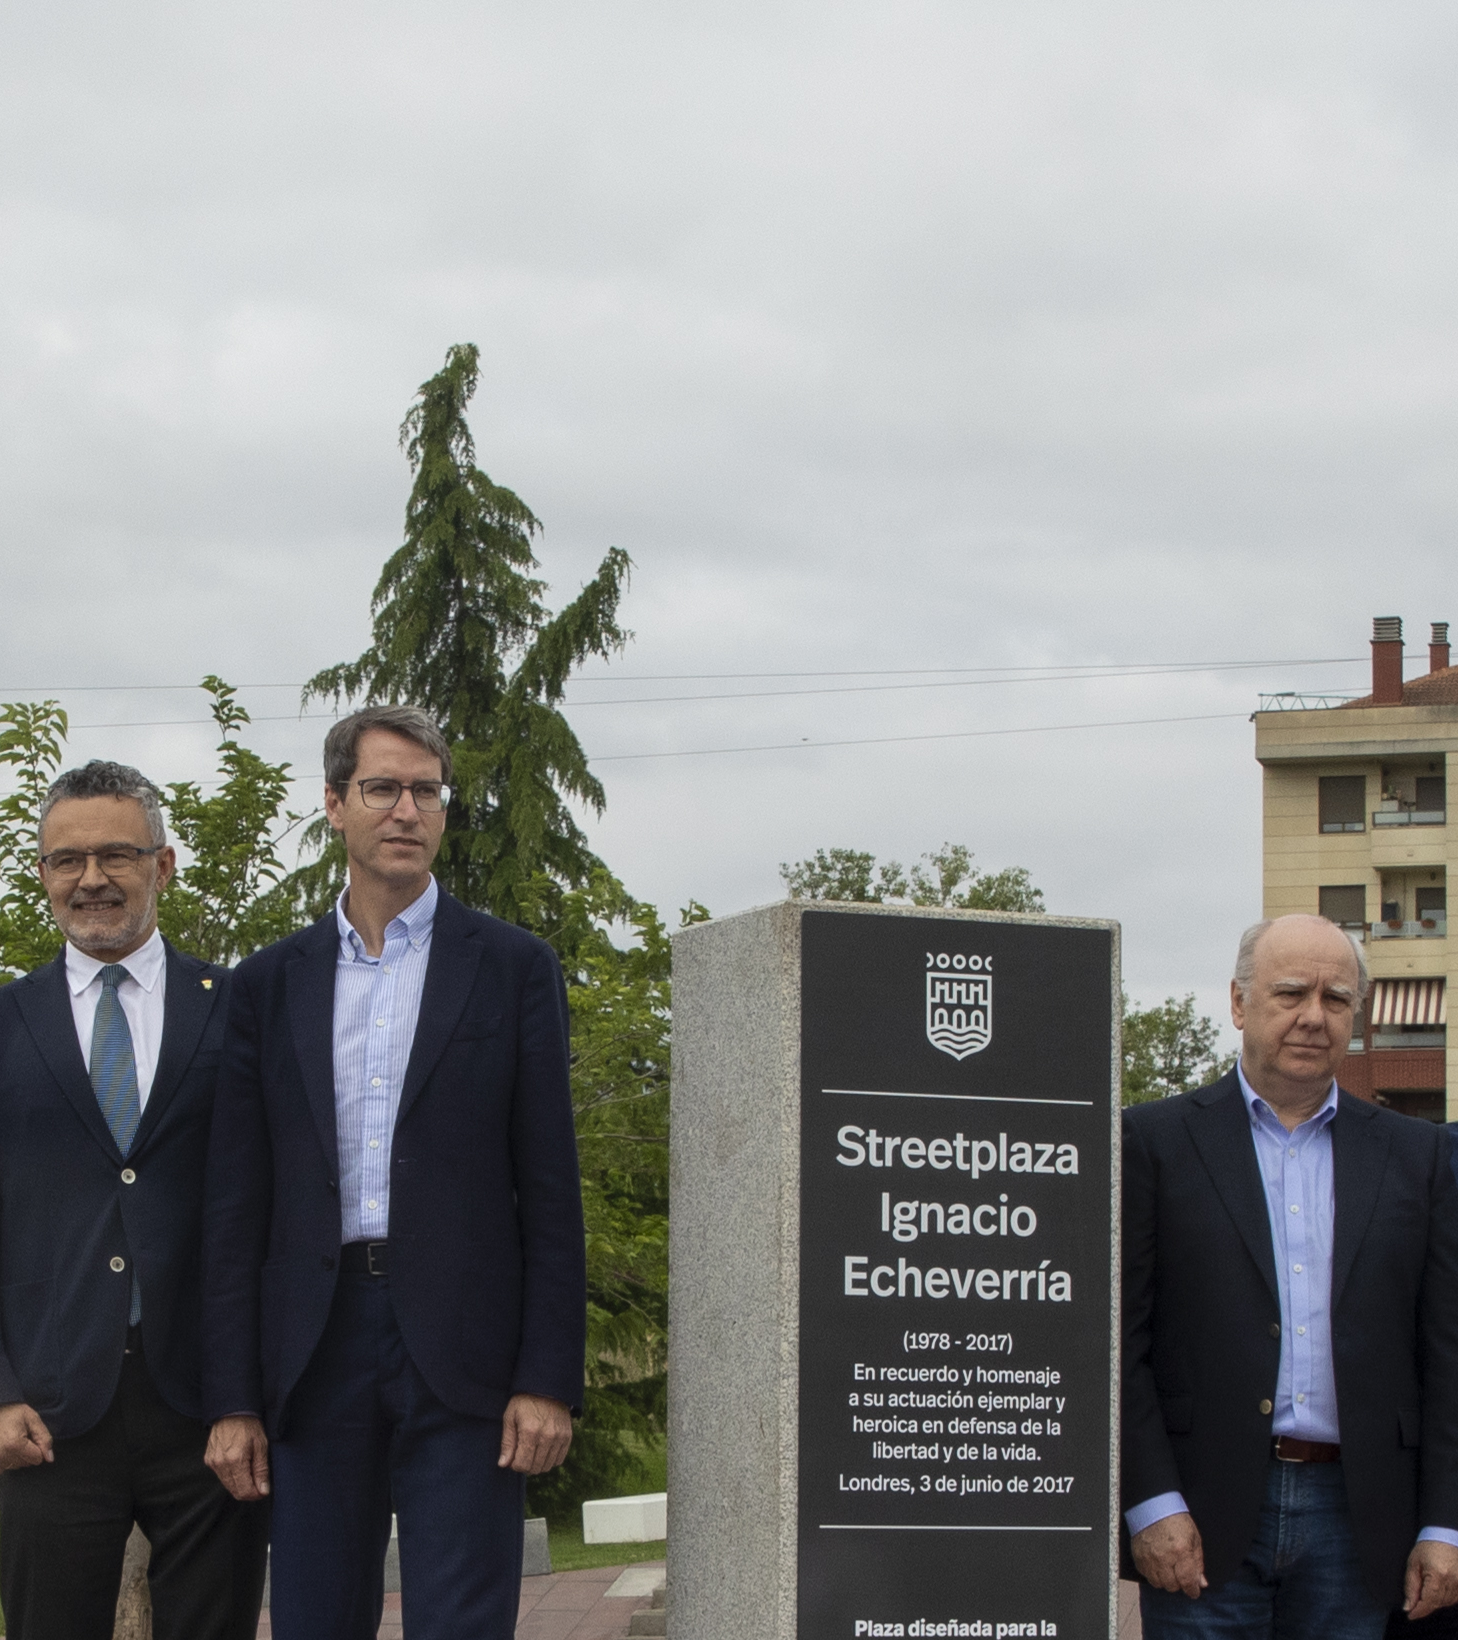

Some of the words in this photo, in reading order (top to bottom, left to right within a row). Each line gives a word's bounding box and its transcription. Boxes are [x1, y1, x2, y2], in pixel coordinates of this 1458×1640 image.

[835, 1124, 1080, 1180] Streetplaza
[881, 1191, 1038, 1243] Ignacio
[844, 1255, 1072, 1303] Echeverría
[903, 1330, 951, 1353] (1978
[965, 1332, 1014, 1355] 2017)
[854, 1362, 876, 1381] En
[879, 1364, 960, 1384] recuerdo
[962, 1368, 974, 1387] y
[976, 1365, 1061, 1389] homenaje
[848, 1392, 860, 1407] a
[862, 1392, 884, 1407] su
[887, 1390, 974, 1409] actuación
[977, 1390, 1053, 1413] ejemplar
[1055, 1396, 1066, 1414] y
[852, 1414, 919, 1434] heroica
[921, 1419, 944, 1434] en
[947, 1416, 1017, 1436] defensa
[1020, 1417, 1043, 1436] de
[1046, 1418, 1062, 1436] la
[872, 1440, 940, 1460] libertad
[942, 1445, 954, 1464] y
[956, 1442, 980, 1461] de
[982, 1442, 998, 1461] la
[1000, 1442, 1042, 1462] vida.
[839, 1473, 916, 1496] Londres,
[919, 1474, 932, 1493] 3
[934, 1474, 958, 1493] de
[959, 1473, 1004, 1497] junio
[1006, 1475, 1029, 1494] de
[1032, 1475, 1075, 1494] 2017
[854, 1619, 905, 1638] Plaza
[907, 1617, 993, 1638] diseñada
[995, 1622, 1038, 1640] para
[1040, 1619, 1057, 1637] la
